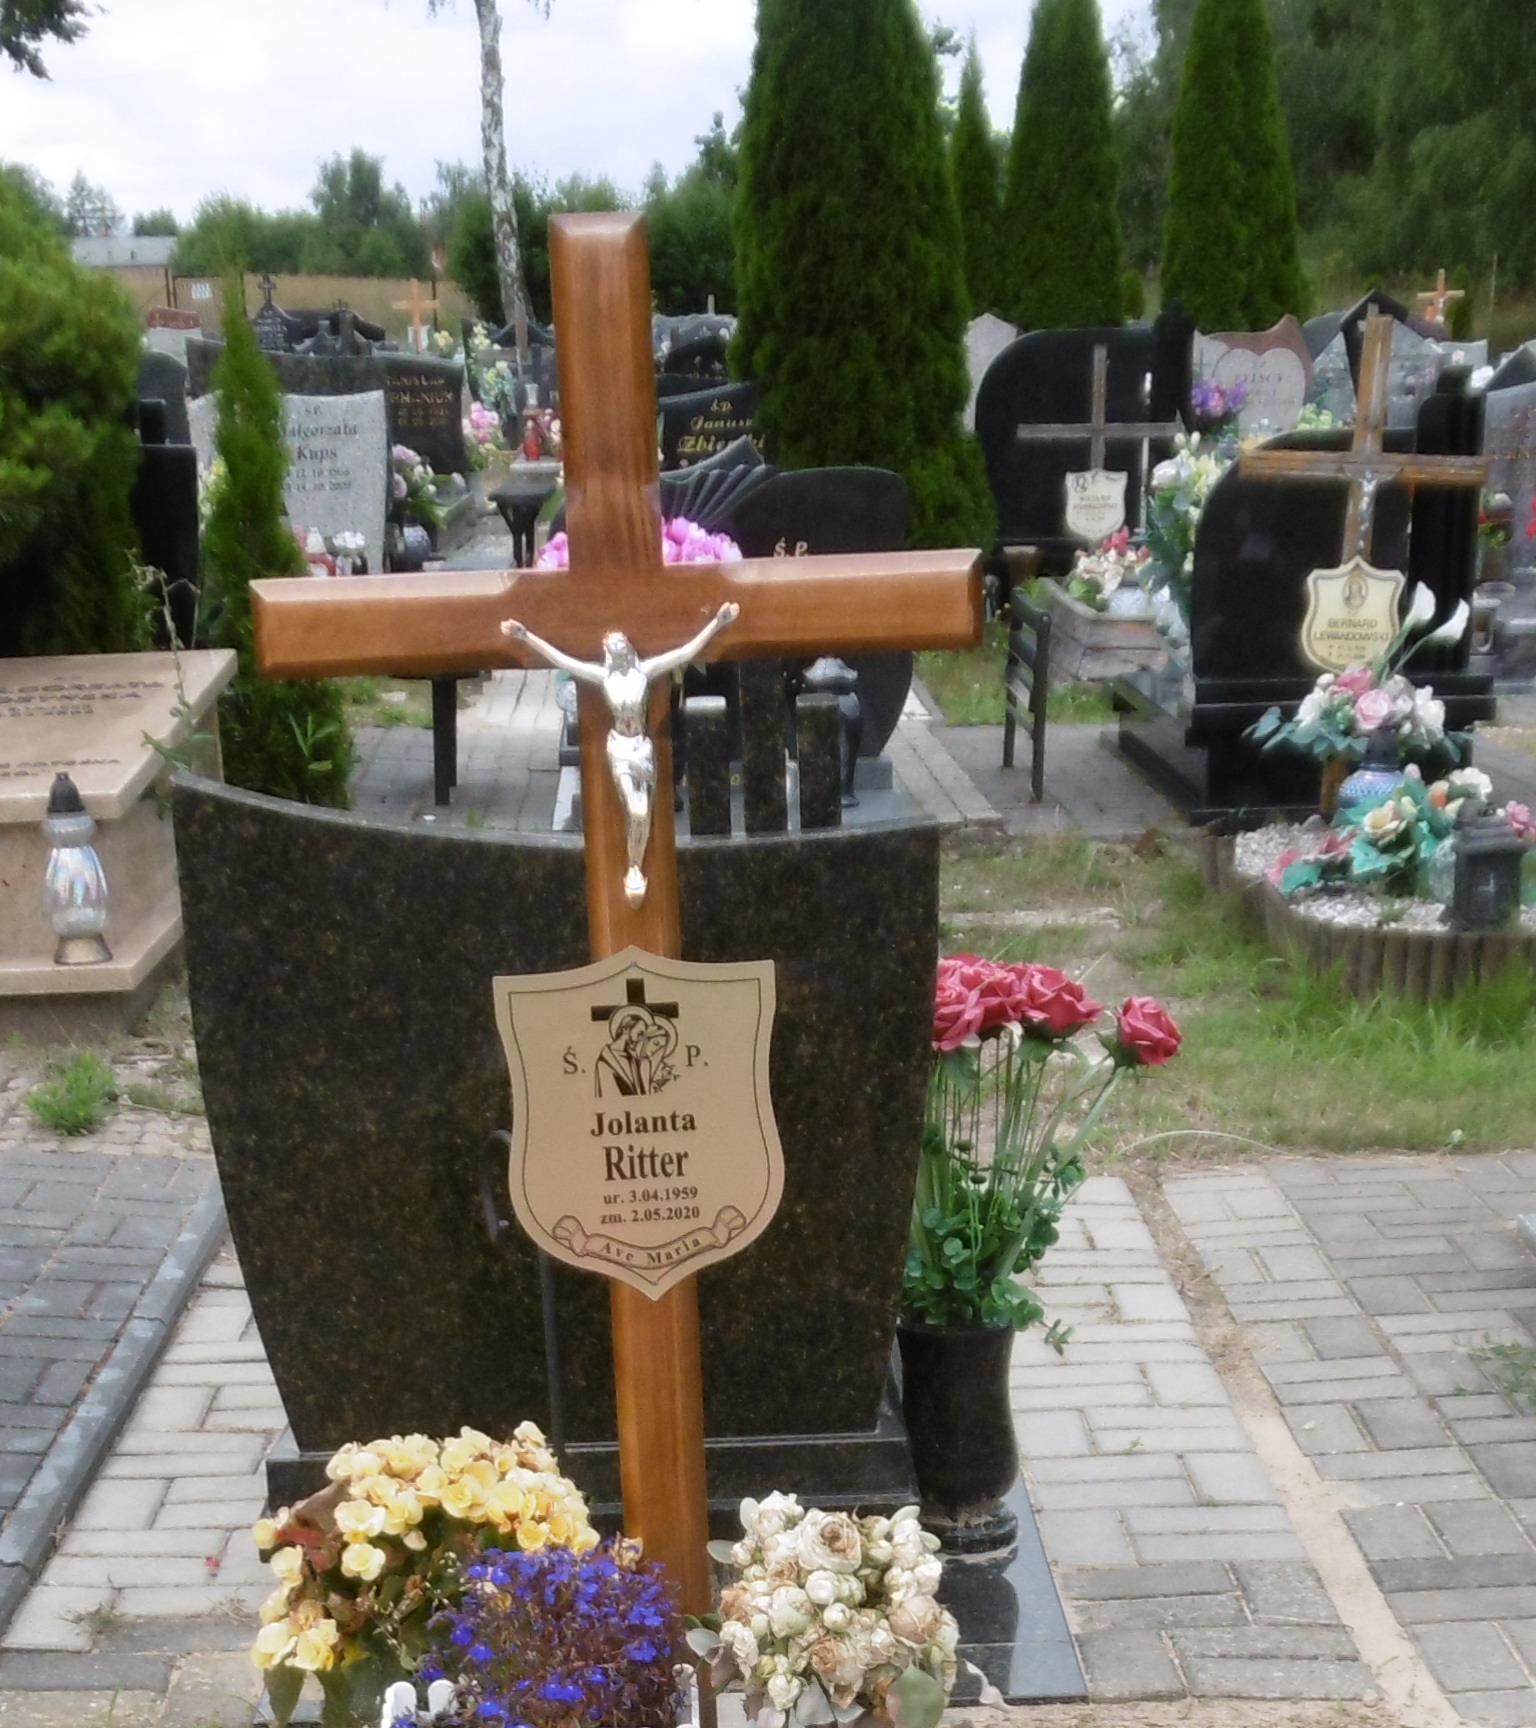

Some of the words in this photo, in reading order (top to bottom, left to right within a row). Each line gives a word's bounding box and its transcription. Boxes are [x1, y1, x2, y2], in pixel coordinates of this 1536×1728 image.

[684, 1044, 710, 1068] P.
[589, 1109, 697, 1138] Jolanta
[602, 1143, 690, 1182] Ritter
[602, 1192, 625, 1205] ur.
[628, 1185, 699, 1203] 3.04.1959
[599, 1212, 627, 1225] zm.
[630, 1204, 701, 1223] 2.05.2020
[600, 1241, 635, 1261] Ave
[646, 1236, 702, 1266] Maria
